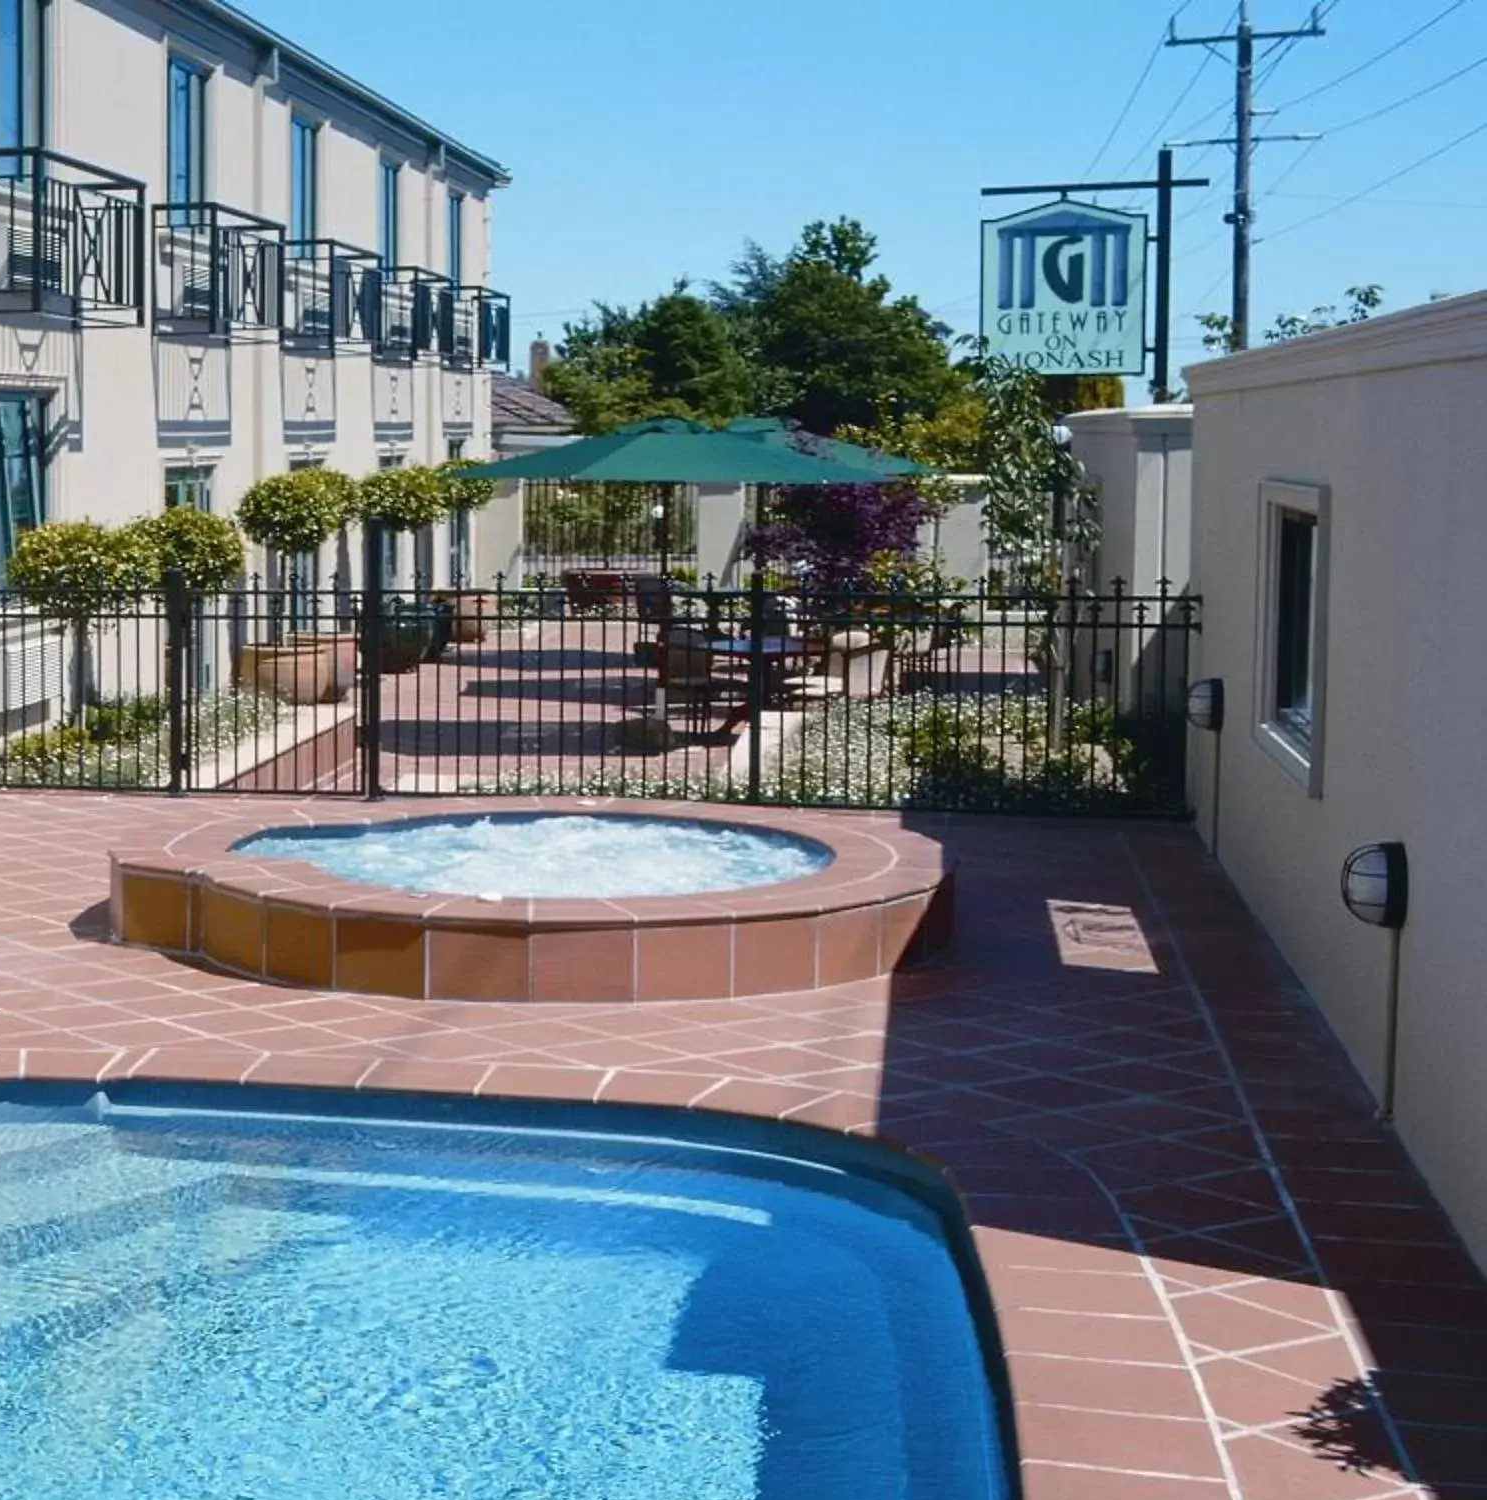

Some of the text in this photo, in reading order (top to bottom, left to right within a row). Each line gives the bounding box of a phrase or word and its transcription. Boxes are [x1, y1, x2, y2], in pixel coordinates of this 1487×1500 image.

[1042, 236, 1084, 304] G
[997, 310, 1127, 335] GATEWAY
[1044, 335, 1077, 350] ON
[999, 350, 1125, 369] MONASH
